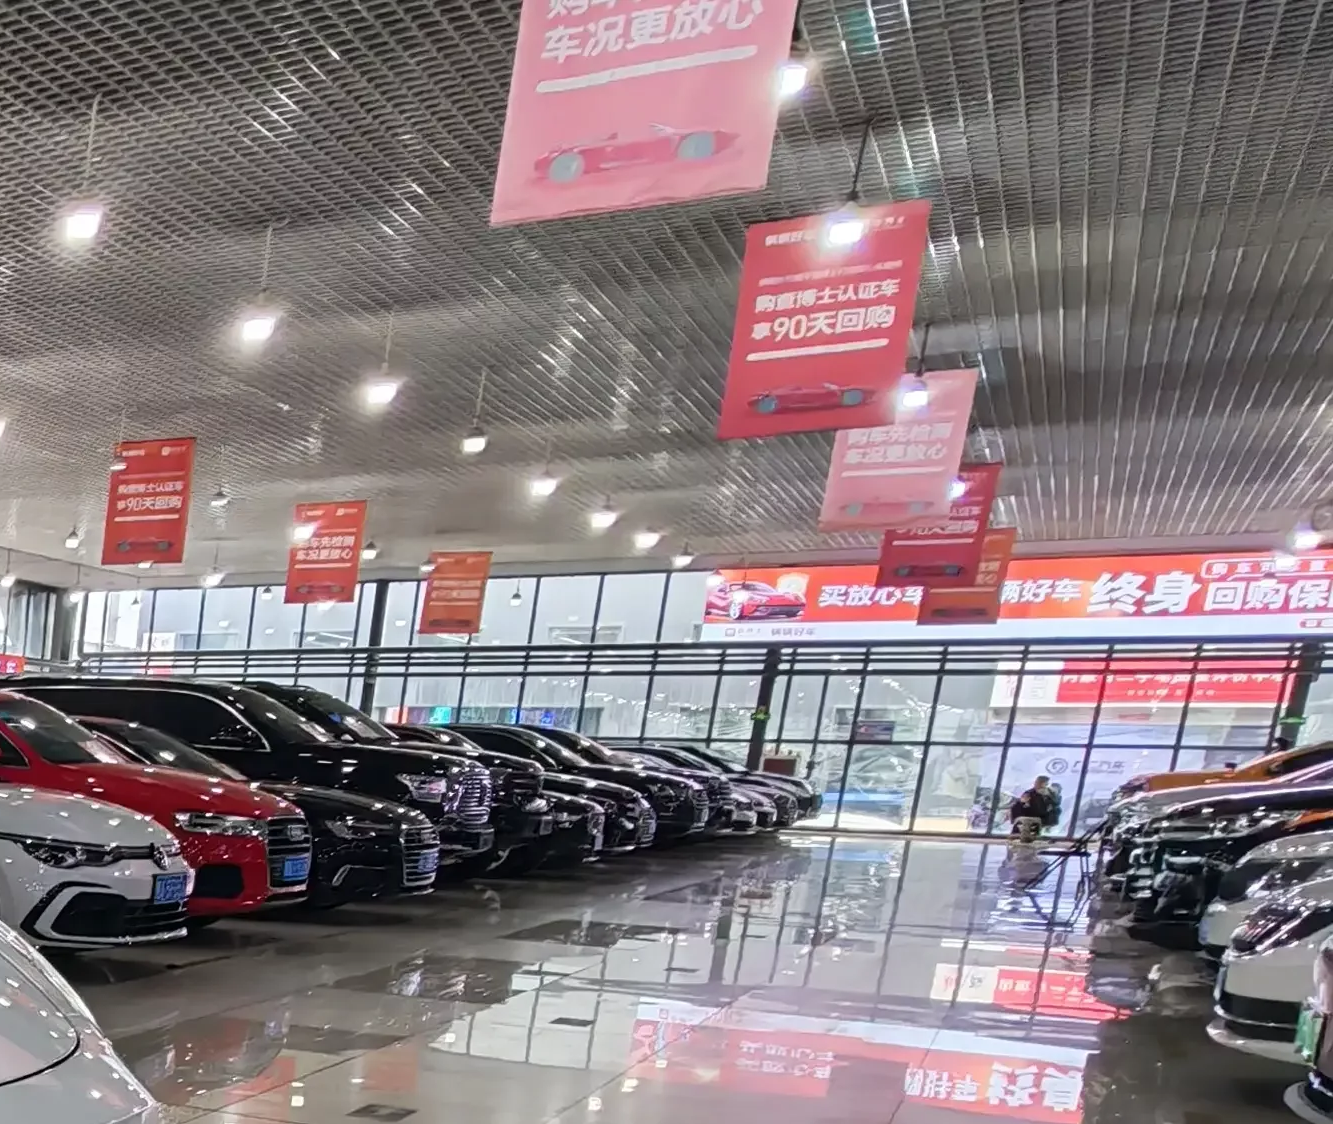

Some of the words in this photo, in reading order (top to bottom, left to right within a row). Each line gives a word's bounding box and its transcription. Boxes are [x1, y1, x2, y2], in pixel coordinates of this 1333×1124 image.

[540, 0, 764, 64] 车况更放心
[1086, 571, 1202, 615] 终身
[1203, 577, 1333, 612] 回购保
